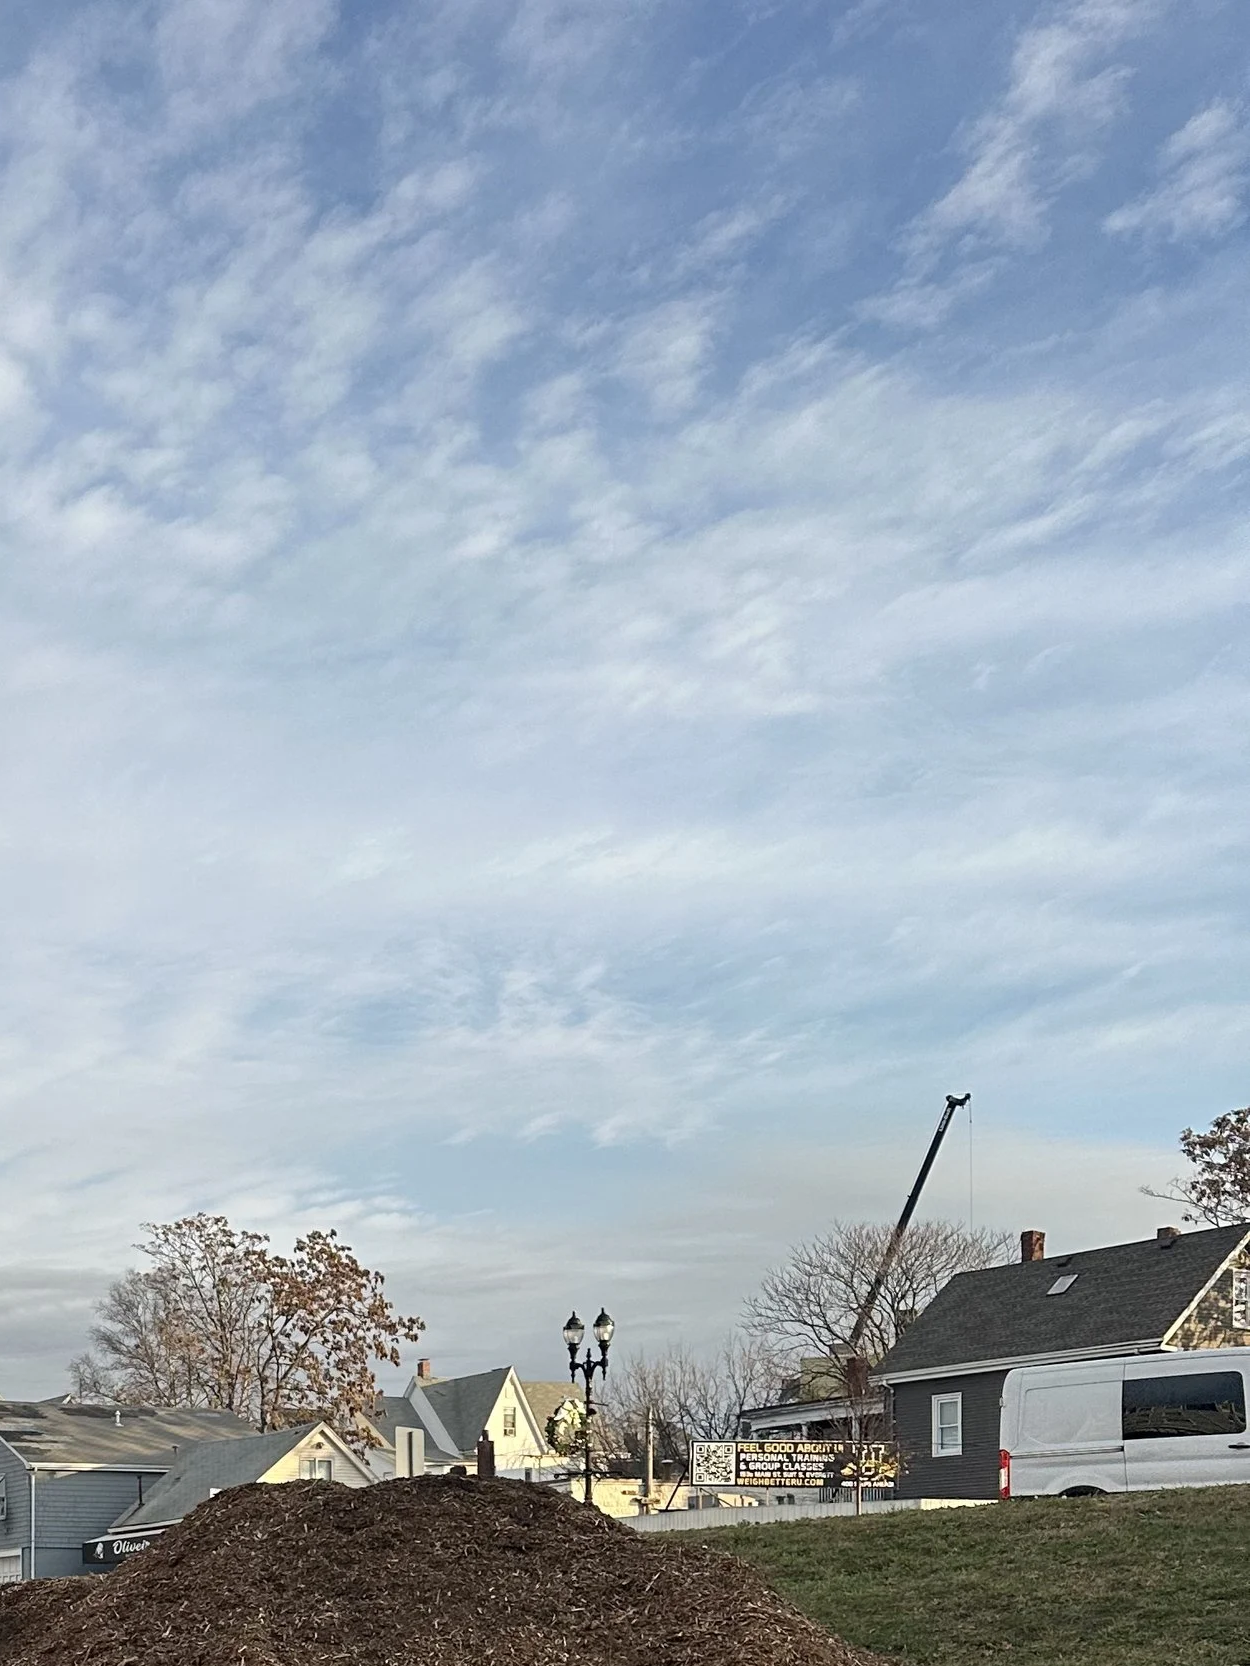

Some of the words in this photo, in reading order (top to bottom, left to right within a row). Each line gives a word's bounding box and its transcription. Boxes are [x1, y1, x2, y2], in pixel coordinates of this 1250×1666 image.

[737, 1443, 762, 1452] FEEL
[764, 1443, 794, 1452] GOOD
[740, 1453, 789, 1461] PERSONAL
[749, 1462, 780, 1470] GROUP
[783, 1462, 825, 1471] CLASSES
[736, 1478, 824, 1486] WEIGHBETTERU.COM
